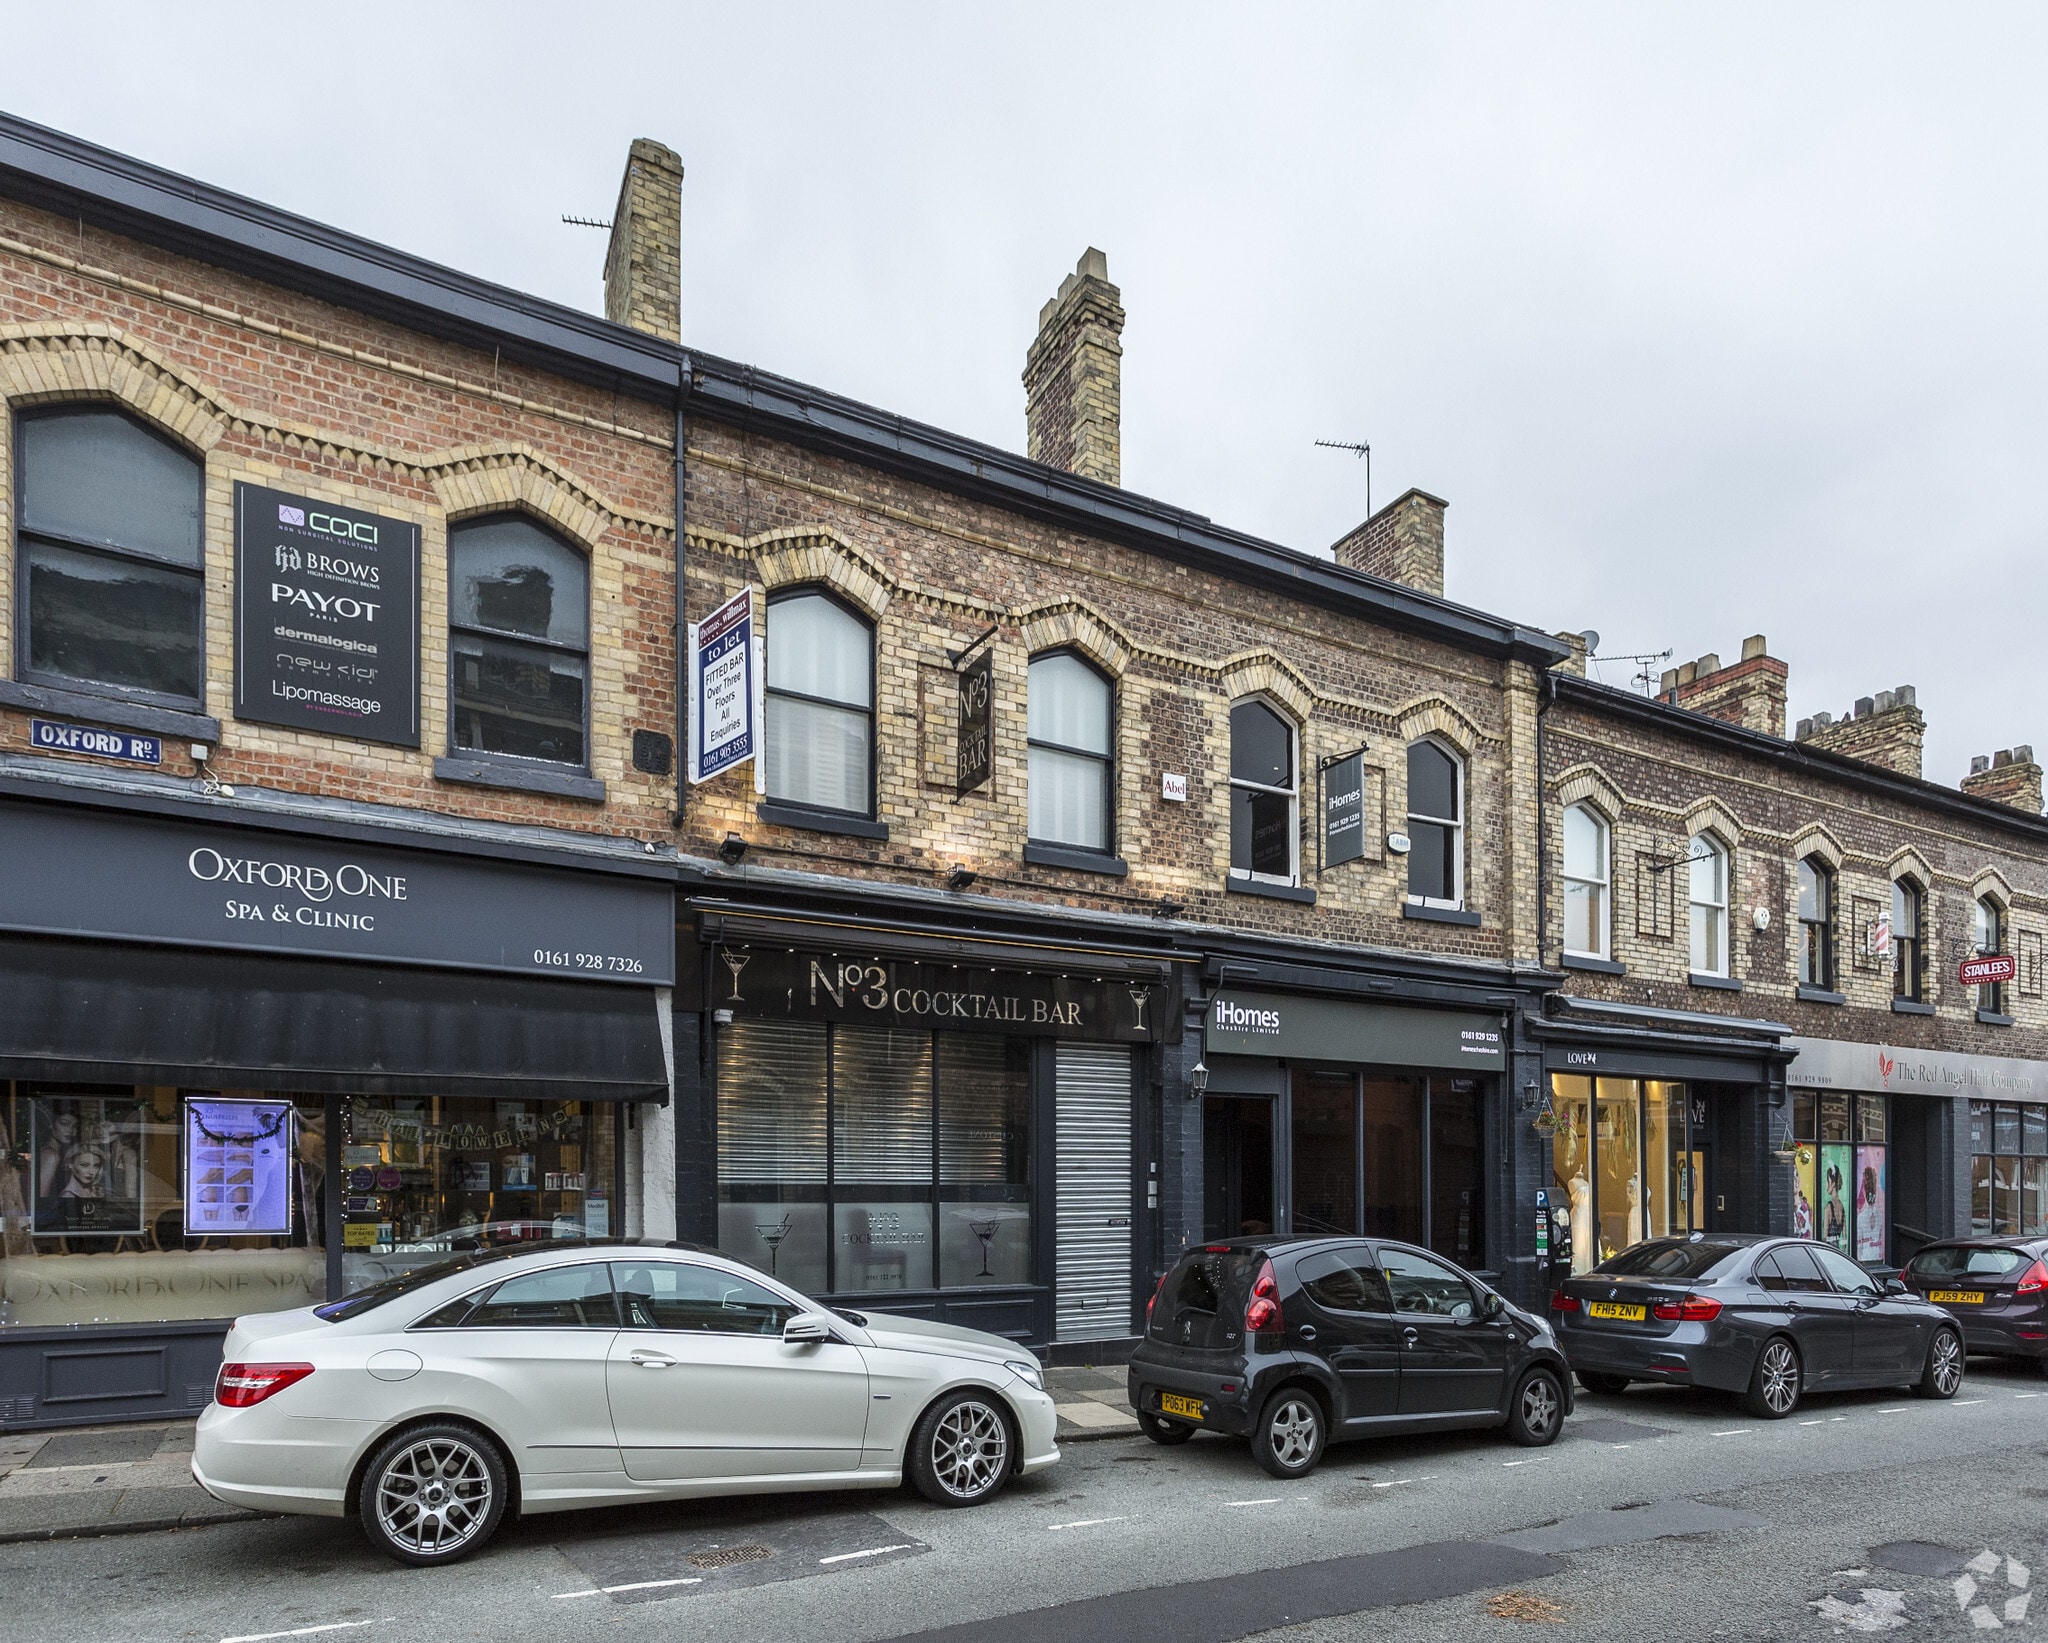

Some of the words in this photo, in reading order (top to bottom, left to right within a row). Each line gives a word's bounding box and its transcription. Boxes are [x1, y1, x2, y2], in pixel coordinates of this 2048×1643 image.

[298, 529, 334, 542] SURGICAL
[338, 538, 378, 552] SOLUTIONS
[307, 552, 379, 583] BROWS
[307, 570, 324, 578] HIGH
[325, 573, 359, 586] DEFINITION
[360, 581, 380, 590] BROWS
[271, 583, 381, 622] PAYOT
[722, 599, 747, 624] willmax
[309, 612, 338, 623] PARIS
[274, 626, 378, 654] dermalogica
[708, 647, 720, 662] to
[724, 630, 741, 652] let
[276, 653, 331, 671] new
[705, 662, 728, 687] FITTED
[729, 651, 744, 672] BAR
[272, 679, 381, 715] Lipomassage
[707, 683, 723, 700] Over
[723, 672, 742, 694] Three
[715, 691, 736, 710] Floors
[721, 707, 730, 721] All
[40, 725, 123, 754] OXFORD
[710, 718, 741, 742] Enquiries
[959, 723, 987, 754] COCKTAIL
[703, 751, 718, 768] 0161
[720, 743, 731, 760] 905
[732, 735, 748, 754] 3555
[959, 738, 987, 781] BAR
[1164, 779, 1185, 795] Abel
[1328, 789, 1360, 811] iHomes
[1329, 821, 1340, 830] 0161
[1340, 817, 1348, 826] 929
[1349, 812, 1360, 823] 1235
[188, 847, 334, 902] OXFORD
[336, 864, 408, 901] ONE
[225, 899, 265, 921] SPA
[272, 903, 292, 923] &
[295, 907, 374, 931] CLINIC
[533, 949, 570, 967] 0161
[576, 953, 603, 969] 928
[607, 956, 643, 973] 7326
[893, 987, 1027, 1022] COCKTAIL
[1031, 999, 1084, 1026] BAR
[1216, 1000, 1280, 1028] iHomes
[1216, 1024, 1248, 1032] Cheshire
[1252, 1027, 1280, 1035] Limited
[1461, 1030, 1475, 1039] 0161
[1475, 1031, 1485, 1040] 929
[1486, 1032, 1498, 1042] 1235
[1567, 1052, 1588, 1065] LOVE
[1787, 1074, 1802, 1082] 0161
[1897, 1062, 1916, 1081] The
[1919, 1064, 1938, 1083] Red
[1940, 1067, 1967, 1089] Angel
[1970, 1068, 1990, 1088] Hair
[1992, 1070, 2033, 1094] Company
[1680, 1108, 1705, 1123] LVE
[1536, 1191, 1545, 1206] P
[1933, 1291, 1958, 1301] PJ59
[1960, 1292, 1980, 1302] ZHY
[1595, 1303, 1617, 1315] FH15
[1619, 1305, 1639, 1317] ZNV
